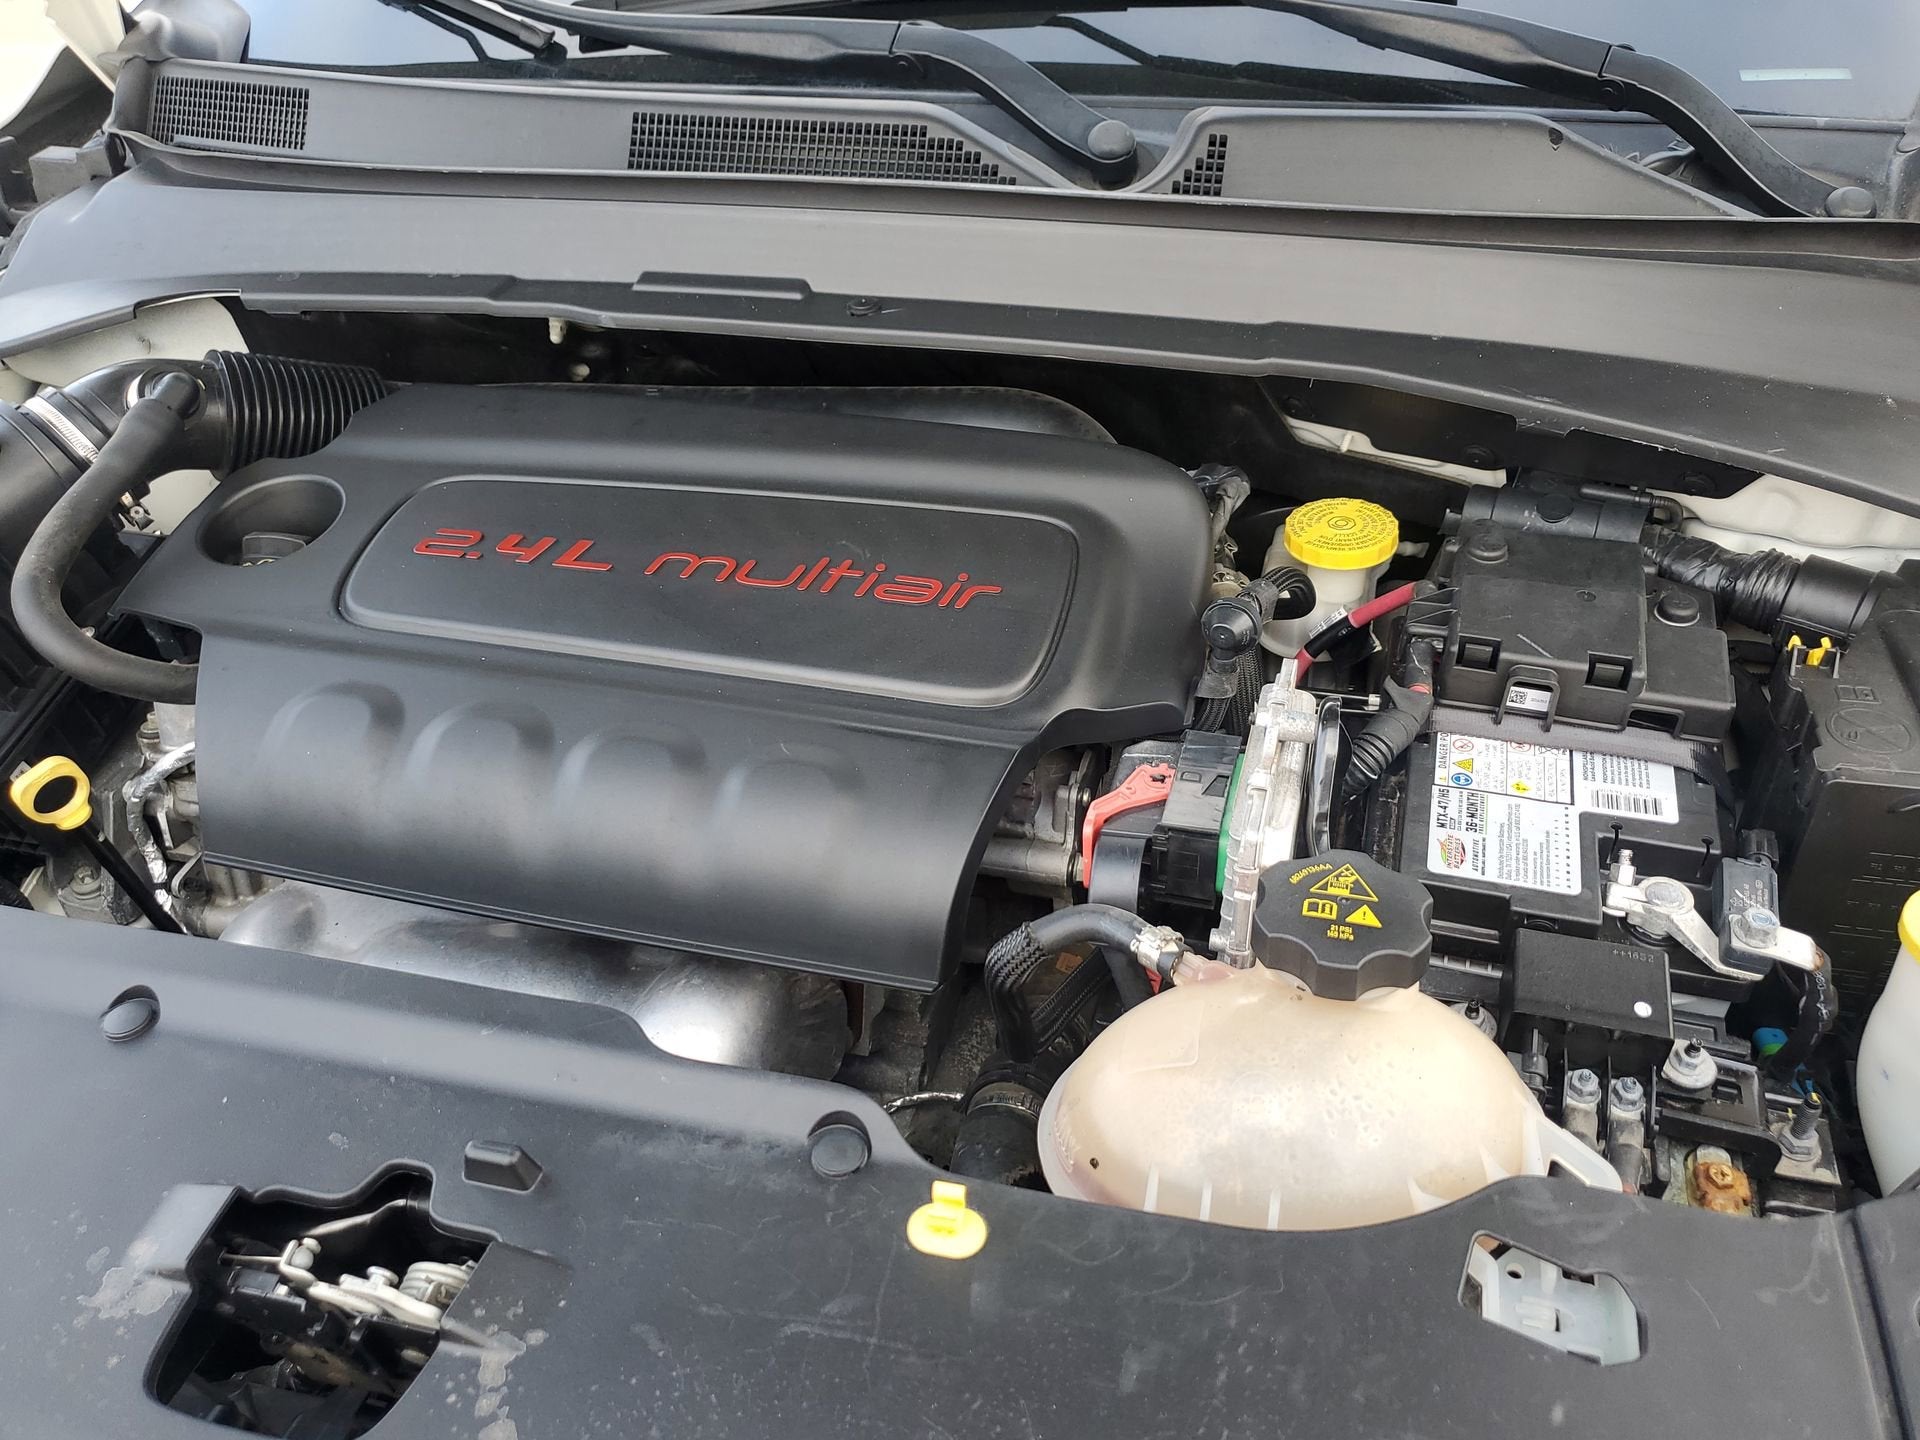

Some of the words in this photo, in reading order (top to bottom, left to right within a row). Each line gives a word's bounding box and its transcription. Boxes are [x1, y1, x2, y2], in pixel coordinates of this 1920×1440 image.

[412, 526, 615, 572] 2.4L
[643, 554, 1004, 609] multiair
[1436, 787, 1451, 829] MTX-47/H5
[1465, 791, 1478, 833] 36-MONTH
[1445, 833, 1453, 868] INTERSTATE
[1453, 837, 1461, 868] BATTERIES
[1471, 838, 1479, 871] AUTOMOTIVE
